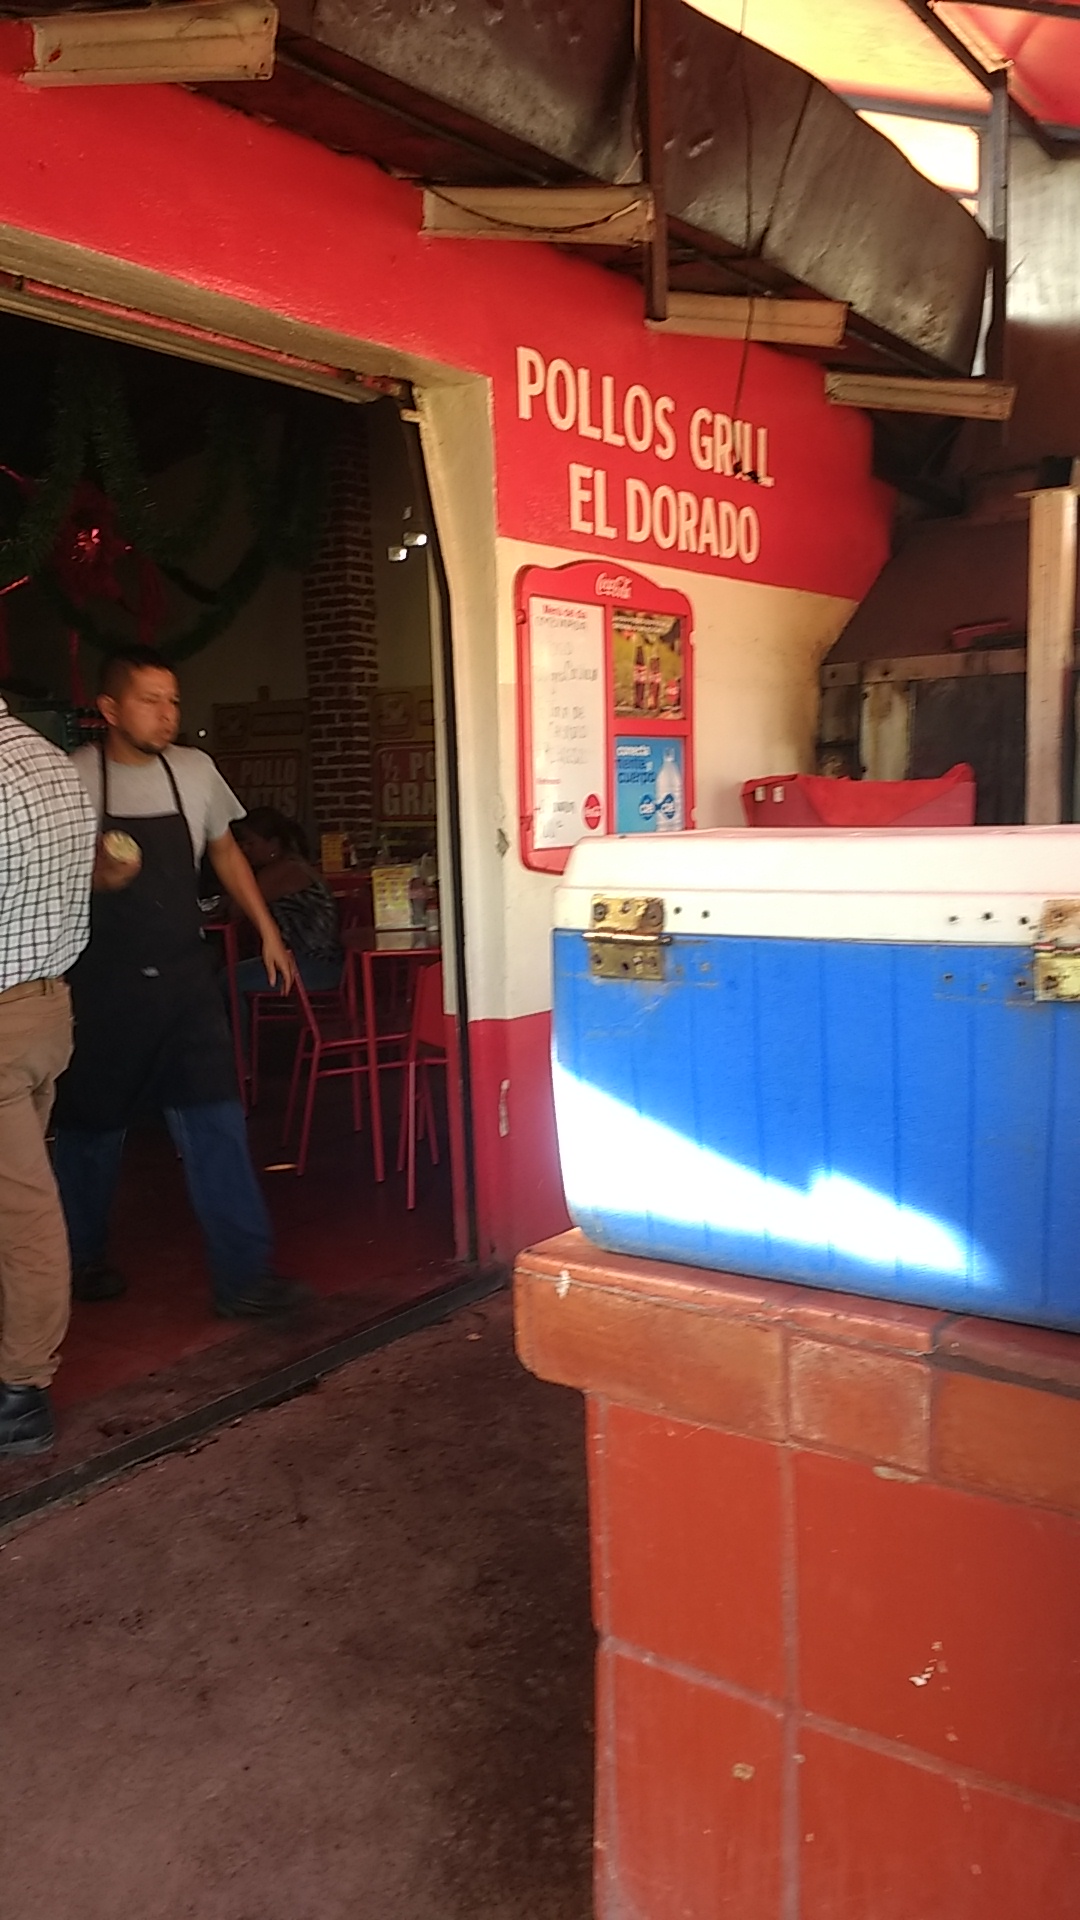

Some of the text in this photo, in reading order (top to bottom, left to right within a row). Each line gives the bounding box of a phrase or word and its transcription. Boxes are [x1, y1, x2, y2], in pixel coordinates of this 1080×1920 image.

[516, 345, 775, 487] POLLOS GRILL
[569, 462, 760, 565] EL DORADO
[240, 758, 298, 787] POLLO
